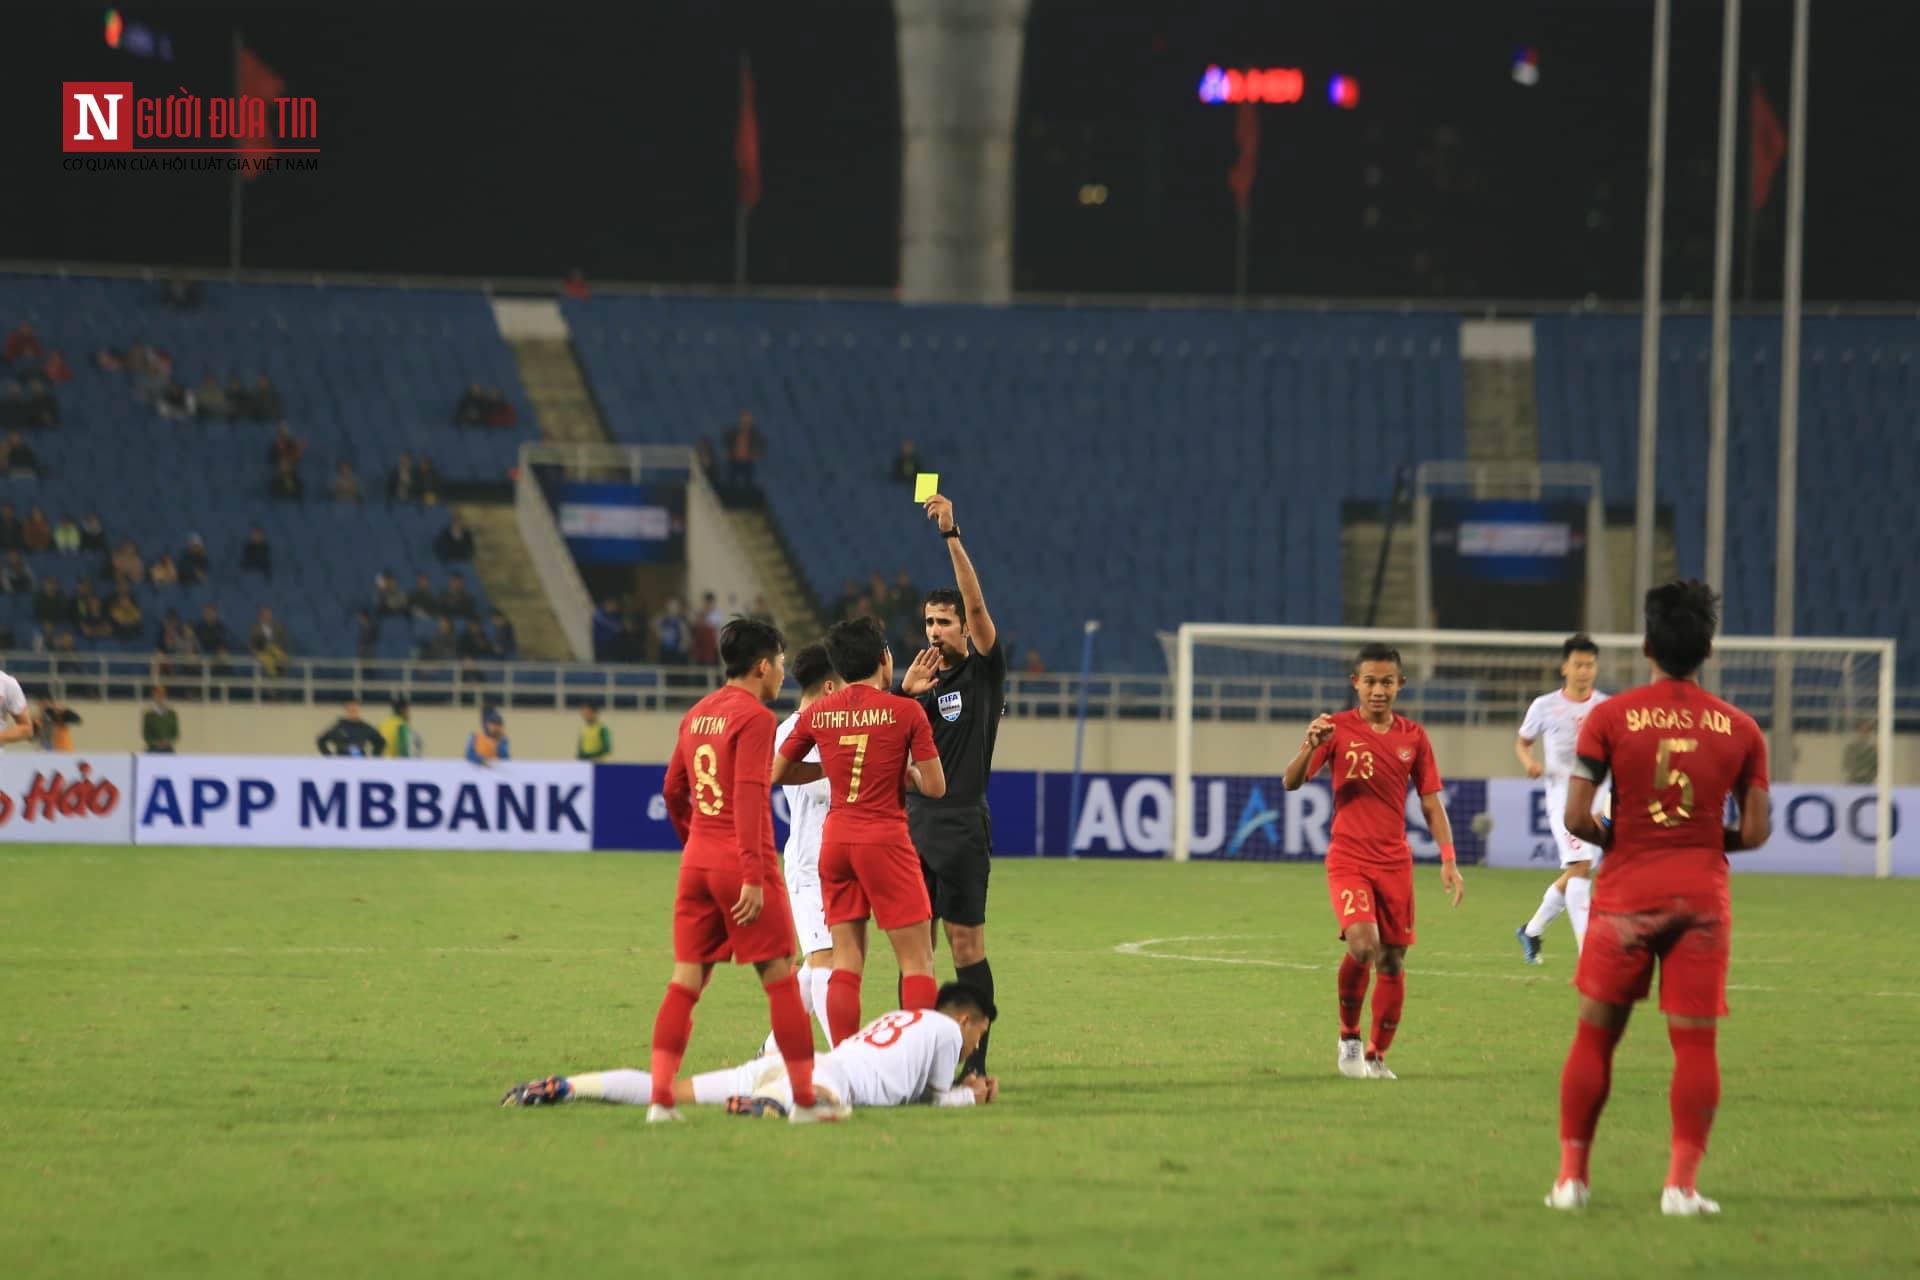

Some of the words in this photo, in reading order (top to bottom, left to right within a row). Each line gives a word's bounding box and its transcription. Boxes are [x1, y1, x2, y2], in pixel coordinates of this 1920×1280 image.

[940, 694, 958, 704] FIFA
[690, 715, 727, 735] WITAN
[811, 711, 849, 729] LUTHFI
[852, 709, 897, 727] KAMAL
[1626, 706, 1694, 732] BAGAS
[1700, 709, 1732, 736] ADI
[693, 744, 724, 816] 8
[839, 734, 869, 803] 7
[1344, 750, 1375, 780] 23
[1648, 738, 1698, 827] 5
[142, 778, 276, 827] APP
[300, 780, 588, 833] MBBANK
[1340, 888, 1371, 916] 23
